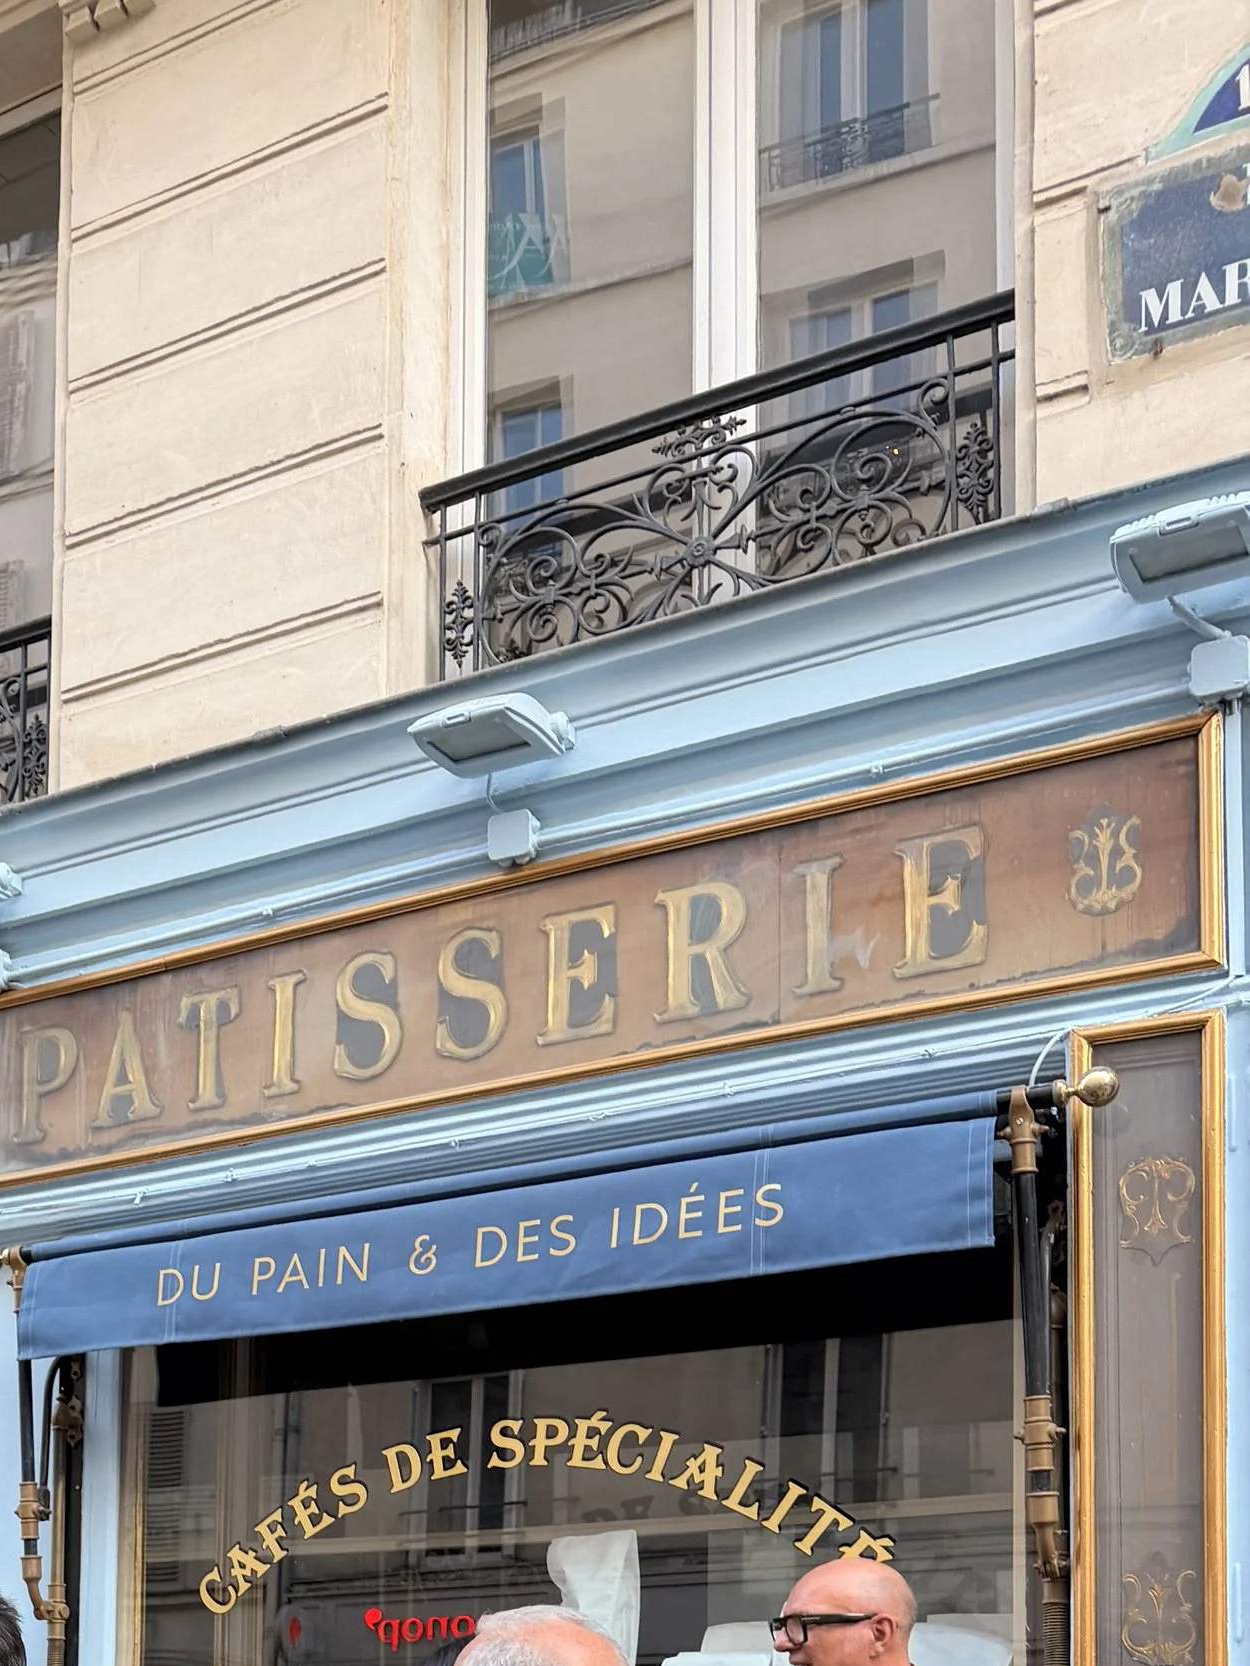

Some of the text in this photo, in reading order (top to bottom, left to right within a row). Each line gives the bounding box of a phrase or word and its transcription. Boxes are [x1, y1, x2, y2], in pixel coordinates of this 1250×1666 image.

[11, 822, 990, 1146] PATISSERIE
[157, 1181, 784, 1308] DU PAIN & DES IDÉES
[199, 1410, 895, 1615] CAFÉS DE SPÉCIALITÉ
